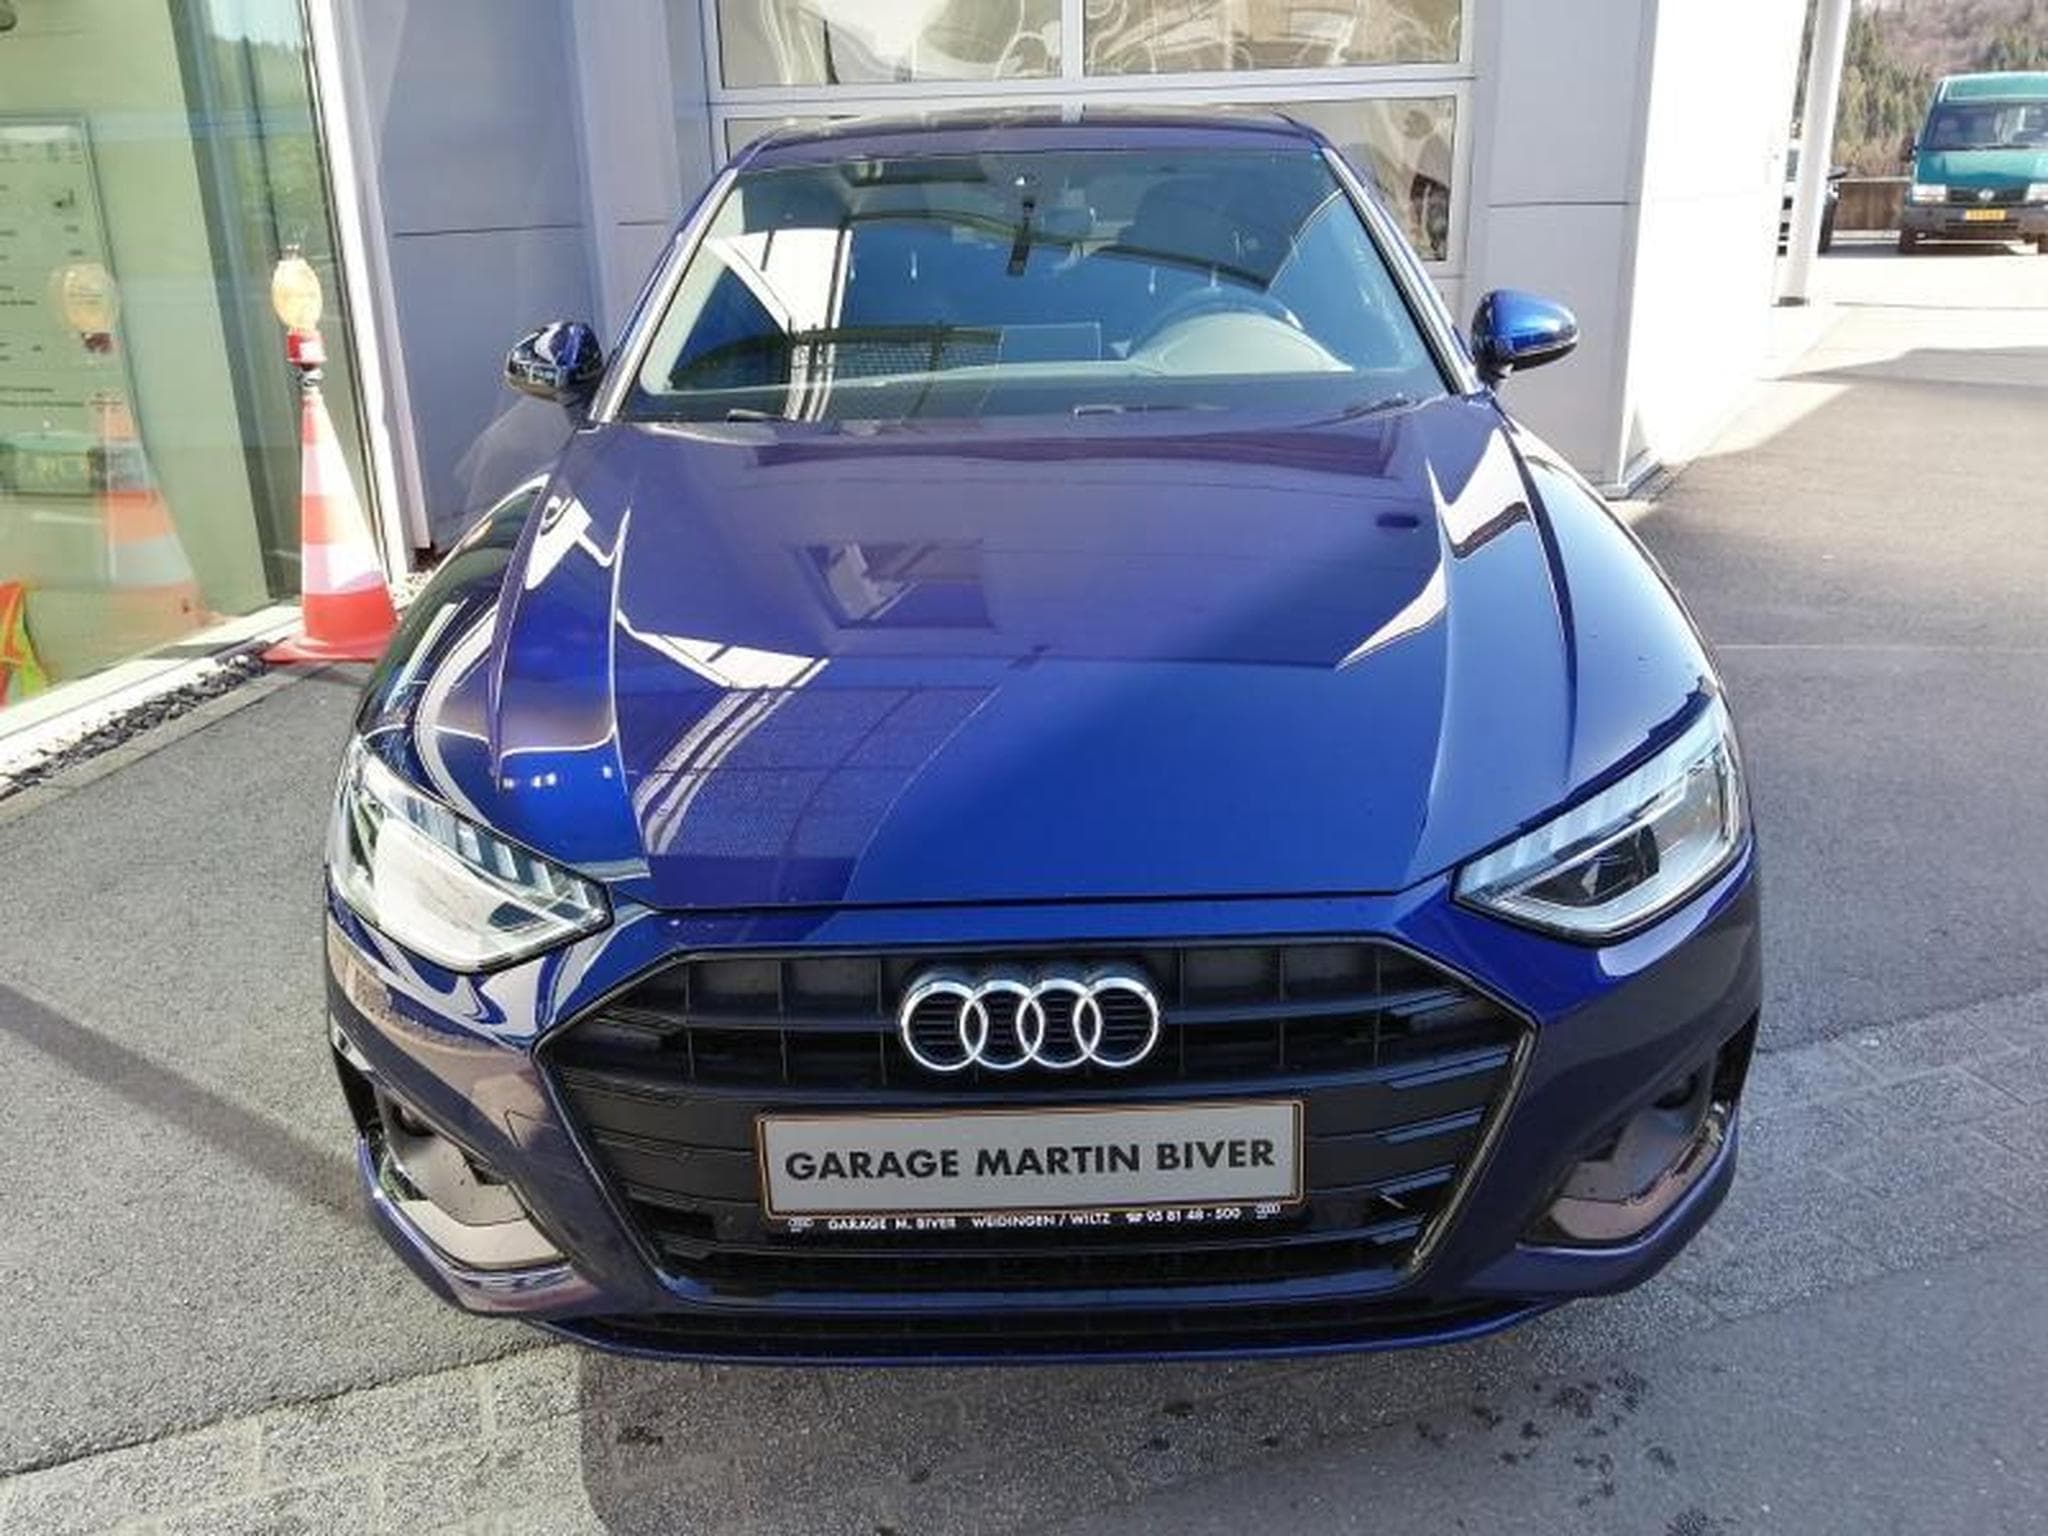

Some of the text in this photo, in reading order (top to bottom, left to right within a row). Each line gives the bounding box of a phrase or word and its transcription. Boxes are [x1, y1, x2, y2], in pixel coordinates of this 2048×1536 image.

[785, 1139, 1275, 1180] GARAGE MARTIN BIVER
[828, 1217, 887, 1230] GARAGE
[916, 1217, 957, 1230] BIVER
[1070, 1212, 1112, 1226] WILTZ
